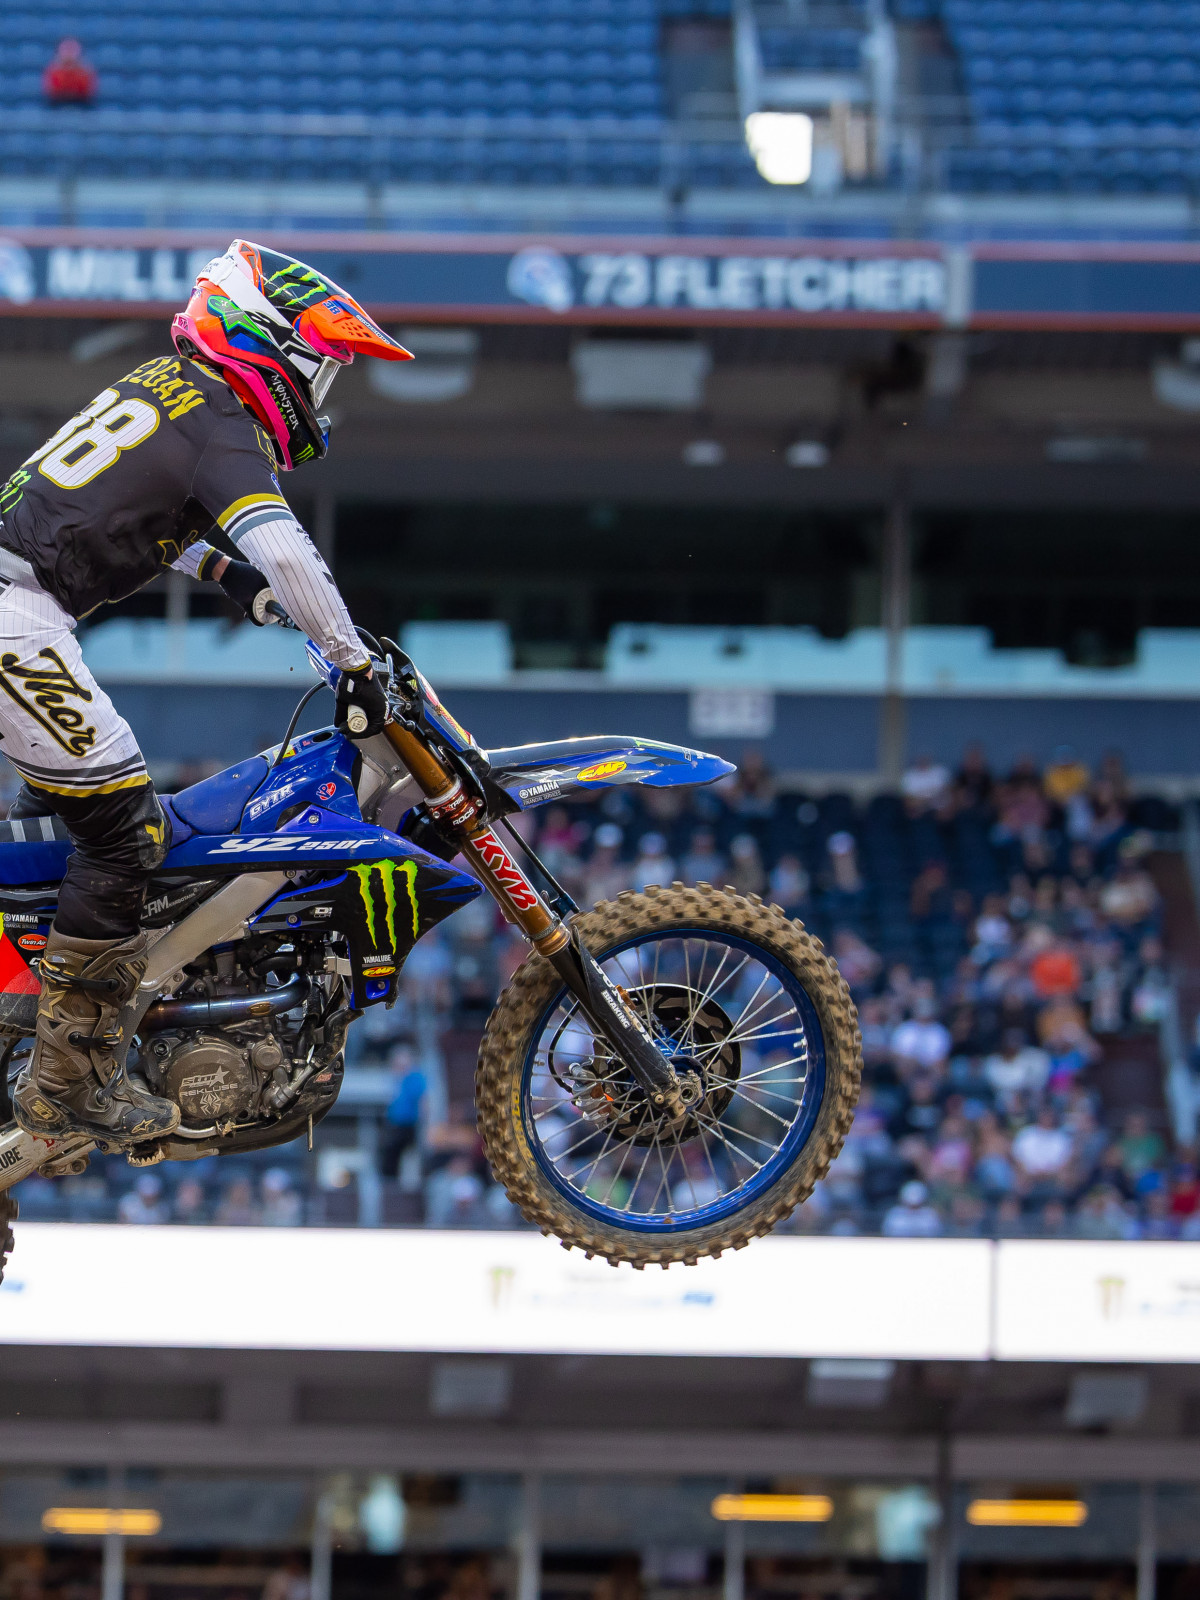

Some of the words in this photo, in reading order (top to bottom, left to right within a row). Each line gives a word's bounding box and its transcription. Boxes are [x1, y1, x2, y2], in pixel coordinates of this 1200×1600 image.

[580, 253, 649, 308] 73
[655, 256, 946, 312] FLETCHER
[271, 373, 299, 430] MONSTER
[250, 783, 295, 818] GYTR
[527, 781, 560, 797] YAMAHA
[470, 831, 539, 911] KYB
[11, 913, 39, 923] YAMAHA
[362, 954, 393, 964] YAMALUBE
[601, 988, 633, 1030] BRAKING
[179, 1083, 238, 1097] REKLUSE
